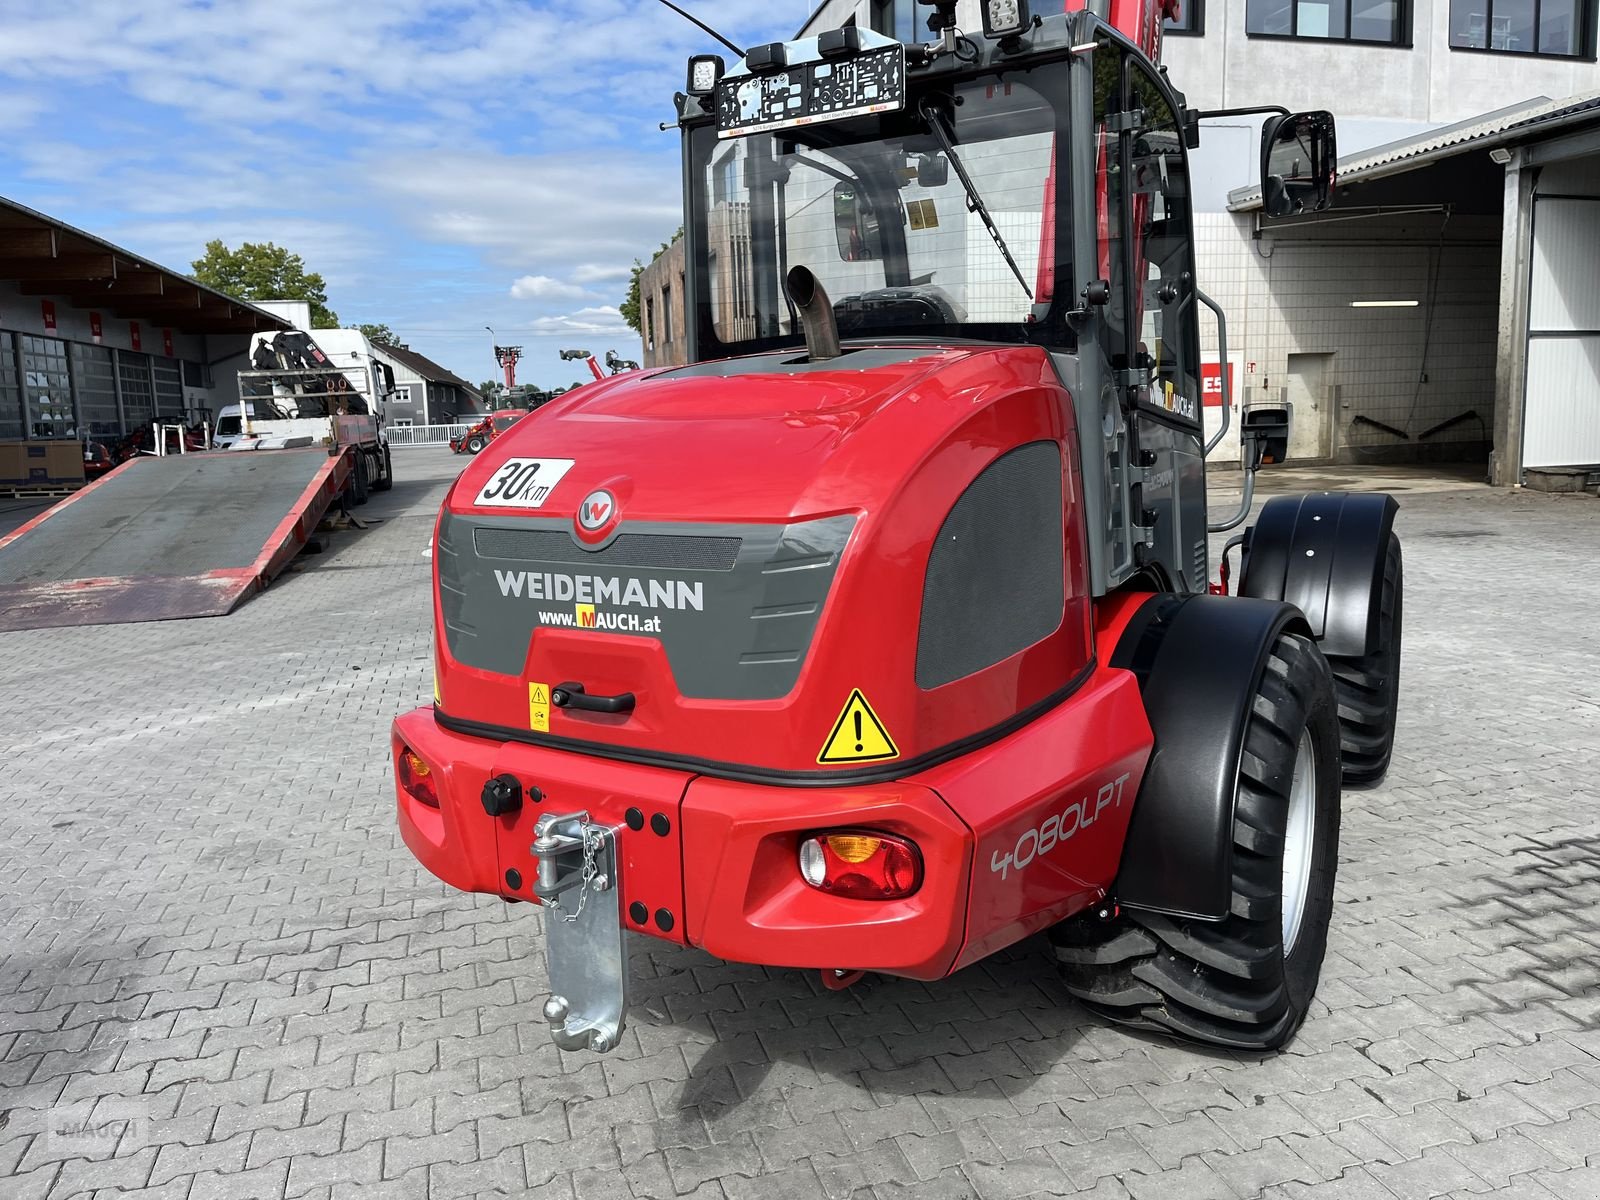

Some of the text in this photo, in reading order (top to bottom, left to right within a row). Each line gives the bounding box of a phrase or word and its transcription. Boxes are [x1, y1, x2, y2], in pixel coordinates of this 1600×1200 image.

[494, 569, 704, 611] WEIDEMANN
[538, 607, 662, 633] www.MAUCH.at
[990, 772, 1130, 880] 4080LPT
